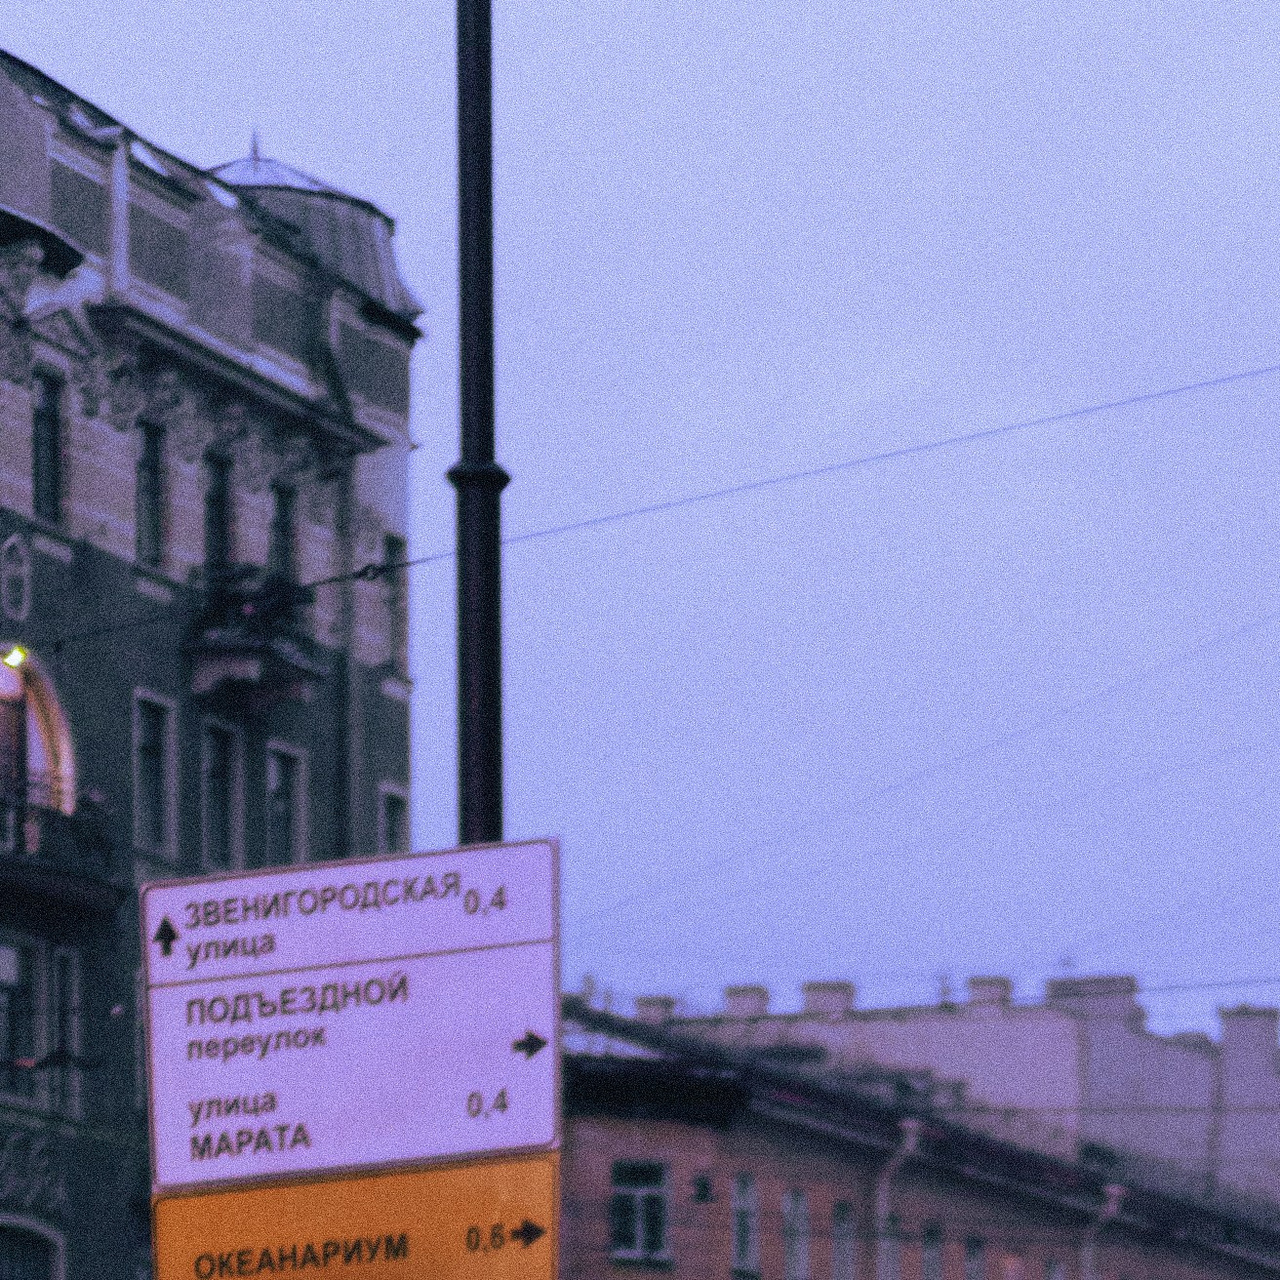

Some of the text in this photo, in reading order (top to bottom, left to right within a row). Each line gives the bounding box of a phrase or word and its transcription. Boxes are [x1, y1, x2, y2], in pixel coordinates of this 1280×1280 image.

[185, 871, 461, 929] ЗВЕНИГОРОДСКАЯ
[464, 887, 507, 916] 0,4
[187, 931, 276, 968] улица
[187, 971, 408, 1026] ПОДЪЕЗДНОЙ
[187, 1027, 326, 1062] переулок
[188, 1091, 277, 1126] улица
[467, 1089, 508, 1120] 0,4
[191, 1123, 311, 1161] МАРАТА
[195, 1233, 408, 1280] ОКЕАНАРИУМ
